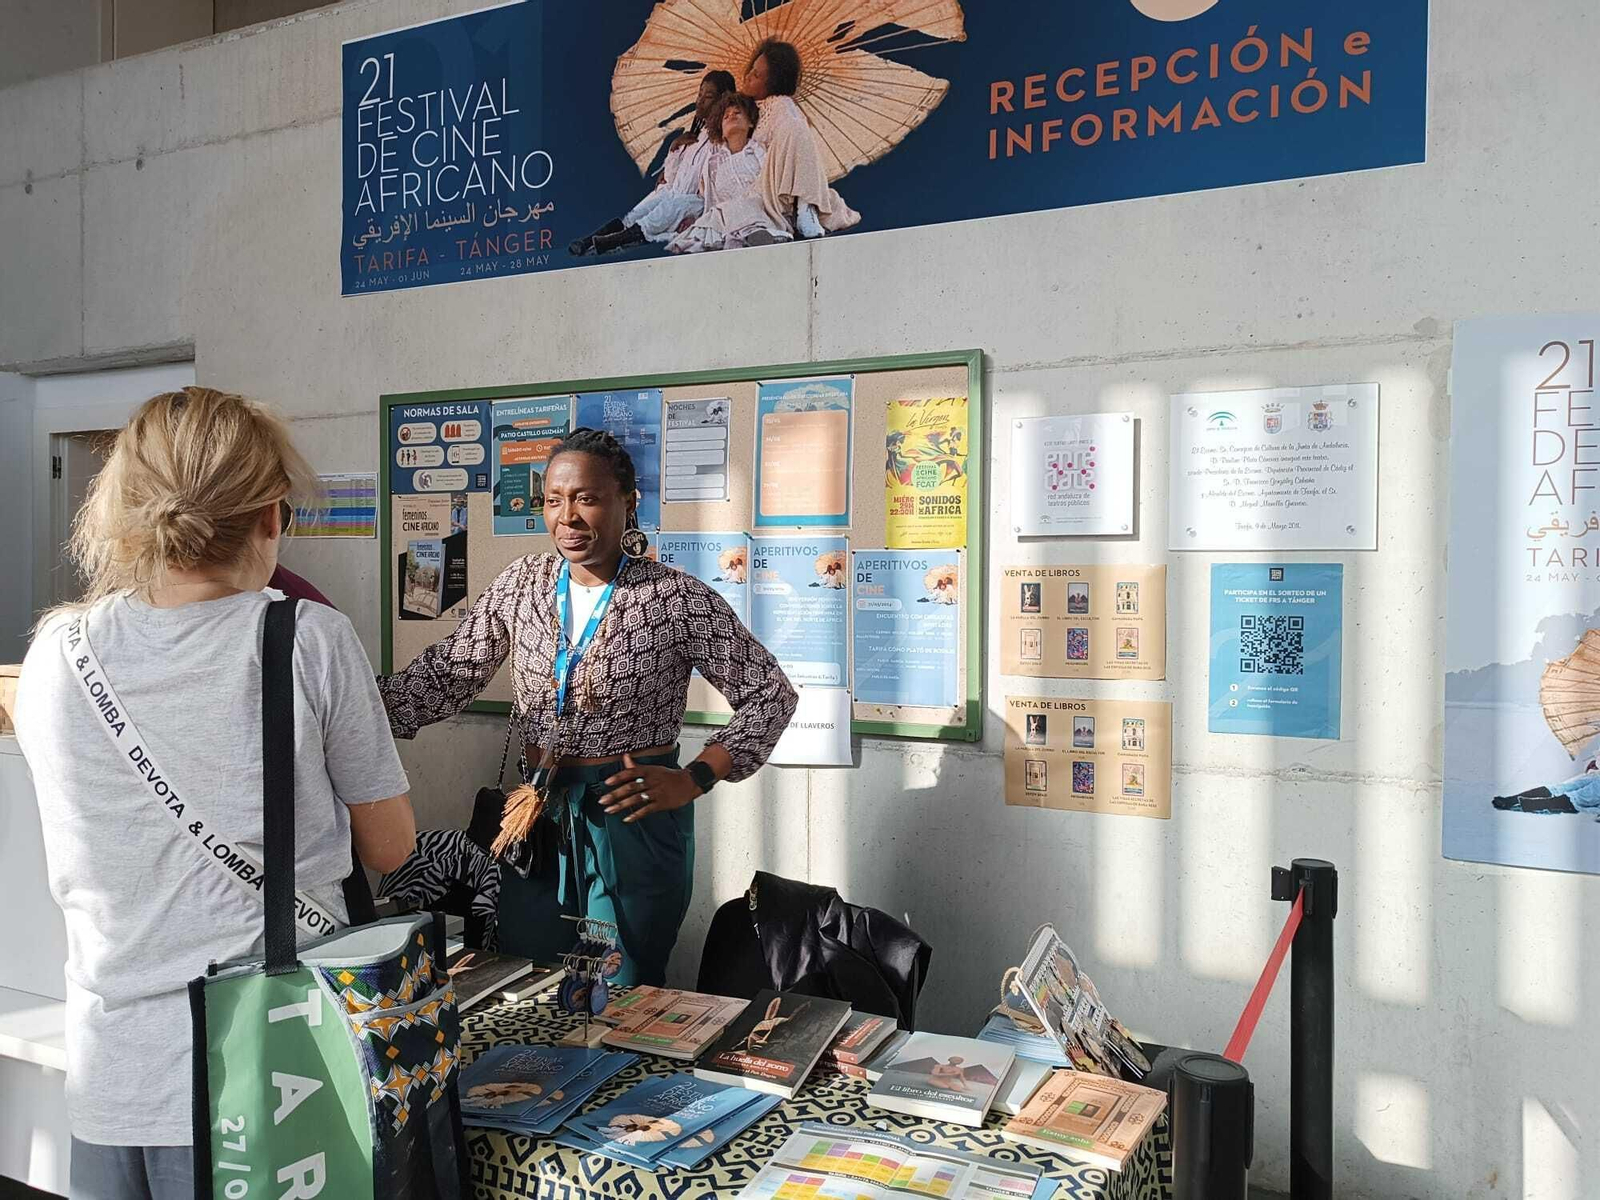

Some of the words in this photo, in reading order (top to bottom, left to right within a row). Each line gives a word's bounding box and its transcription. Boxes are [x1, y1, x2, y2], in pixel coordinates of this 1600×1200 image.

[990, 25, 1313, 115] RECEPCIÓN
[1343, 31, 1371, 56] e
[358, 53, 396, 106] 21
[357, 78, 519, 142] FESTIVAL
[989, 67, 1372, 160] INFORMACIÓN
[357, 135, 398, 178] DE
[412, 117, 502, 168] CINE
[355, 150, 553, 216] AFRICANO
[425, 203, 476, 232] السينما
[483, 199, 555, 228] مهرجان
[352, 214, 418, 249] الإفريقي
[353, 248, 430, 275] TARIFA
[456, 228, 553, 261] TÁNGER
[460, 266, 473, 277] 24
[475, 262, 499, 275] MAY
[510, 258, 523, 270] 28
[526, 254, 551, 269] MAY
[355, 280, 367, 290] 24
[369, 275, 390, 288] MAY
[398, 274, 408, 284] 01
[410, 270, 430, 283] JUN
[1535, 339, 1595, 390] 21
[604, 395, 611, 403] 21
[403, 407, 441, 418] NORMAS
[442, 406, 455, 416] DE
[457, 405, 479, 415] SALA
[496, 406, 534, 417] ENTRELÍNEAS
[535, 403, 567, 413] TARIFEÑAS
[668, 403, 696, 412] NOCHES
[1533, 389, 1594, 428] FE
[501, 431, 516, 439] PATIO
[517, 429, 541, 437] CASTILLO
[541, 426, 564, 435] GUZMÁN
[1533, 428, 1600, 466] DE
[918, 495, 962, 505] SONIDOS
[402, 522, 420, 532] CINE
[661, 542, 722, 552] APERITIVOS
[753, 546, 819, 556] APERITIVOS
[660, 553, 675, 563] DE
[753, 558, 768, 569] DE
[857, 560, 928, 570] APERITIVOS
[857, 572, 873, 583] DE
[1004, 569, 1033, 577] VENTA
[1035, 569, 1047, 577] DE
[1048, 569, 1081, 577] LIBROS
[1526, 574, 1541, 583] 24
[1549, 572, 1580, 583] MAY
[857, 584, 884, 595] CINE
[1288, 596, 1316, 604] TÁNGER
[1009, 700, 1038, 709] VENTA
[1040, 701, 1052, 710] DE
[1054, 702, 1086, 711] LIBROS
[800, 722, 835, 730] LLAVEROS
[76, 655, 90, 673] &
[83, 670, 127, 738] LOMBA
[128, 745, 186, 819] DEVOTA
[188, 820, 204, 837] &
[202, 834, 264, 891] LOMBA
[719, 1052, 729, 1060] La
[730, 1054, 753, 1064] huella
[753, 1058, 767, 1067] del
[766, 1062, 789, 1072] zorro
[902, 1086, 922, 1094] libro
[923, 1089, 938, 1097] del
[938, 1092, 975, 1103] escultor
